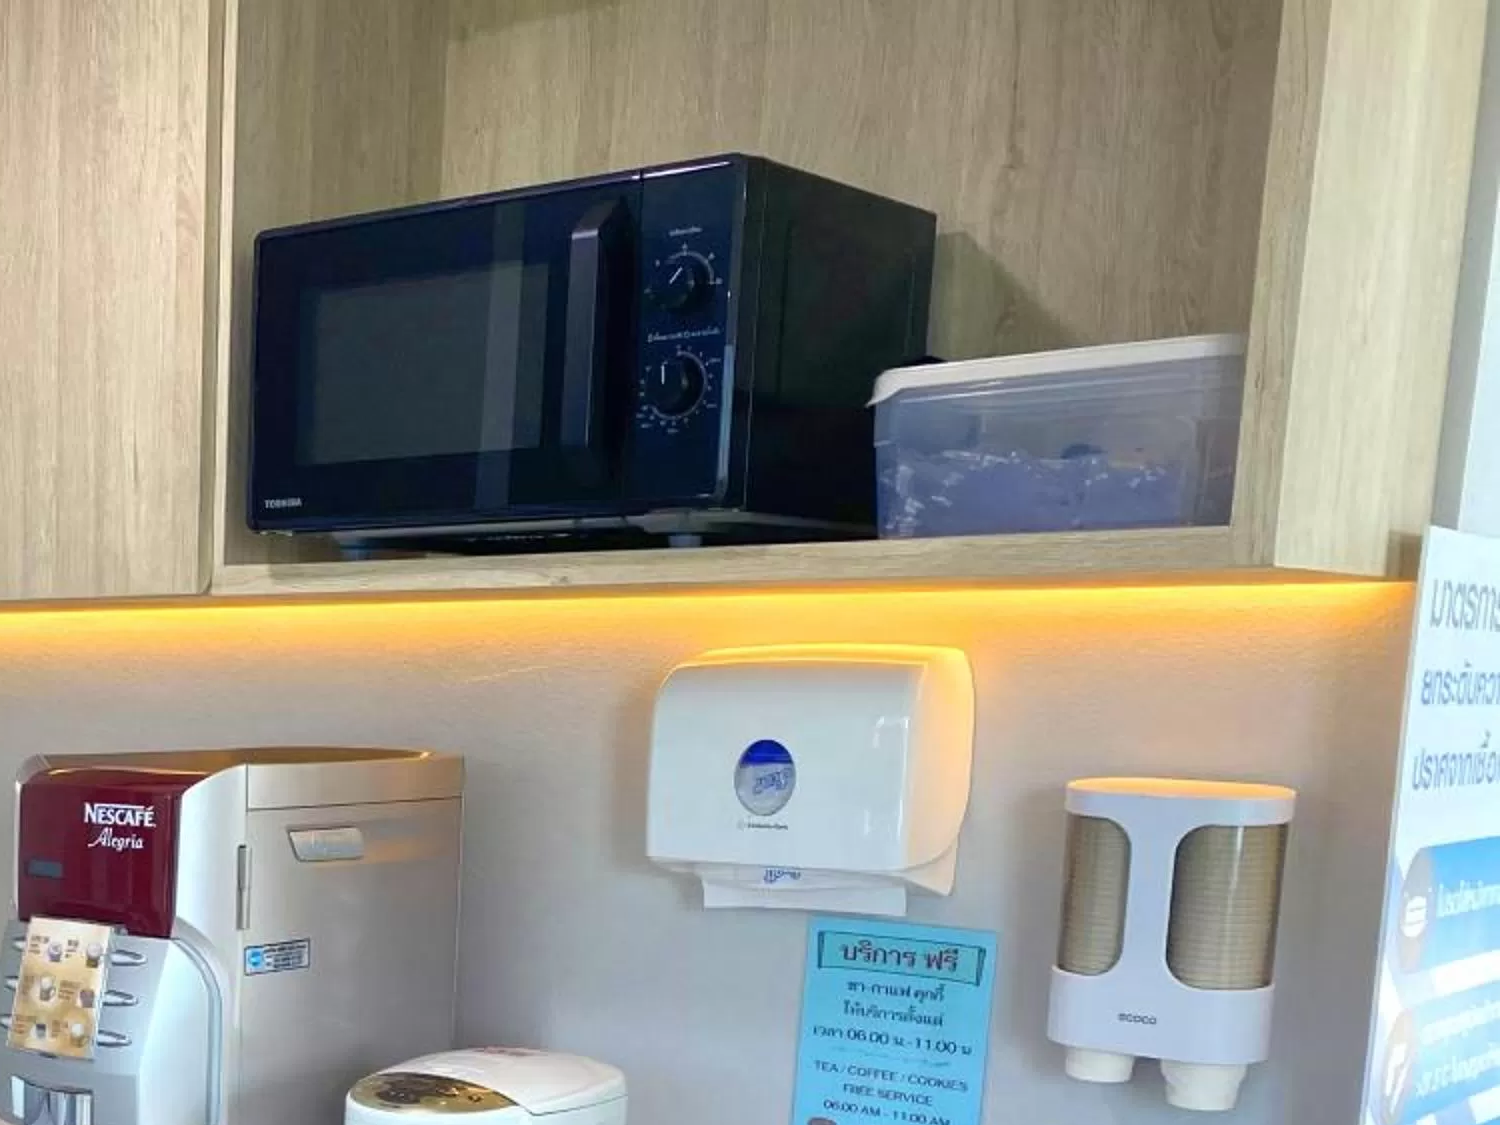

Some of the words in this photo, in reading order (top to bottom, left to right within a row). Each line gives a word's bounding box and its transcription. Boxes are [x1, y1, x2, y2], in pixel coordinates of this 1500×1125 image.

[84, 802, 156, 828] NESCAFÉ
[87, 827, 144, 852] Alegria
[841, 939, 916, 967] บริการ
[926, 947, 959, 972] ฟรี
[813, 1060, 839, 1073] TEA
[847, 1065, 899, 1082] COFFEE
[907, 1073, 968, 1092] COOKIES
[843, 1083, 875, 1096] FREE
[877, 1089, 933, 1107] SERVICE
[823, 1099, 859, 1112] 06.00
[861, 1105, 881, 1117] AM
[893, 1111, 927, 1125] 11.00
